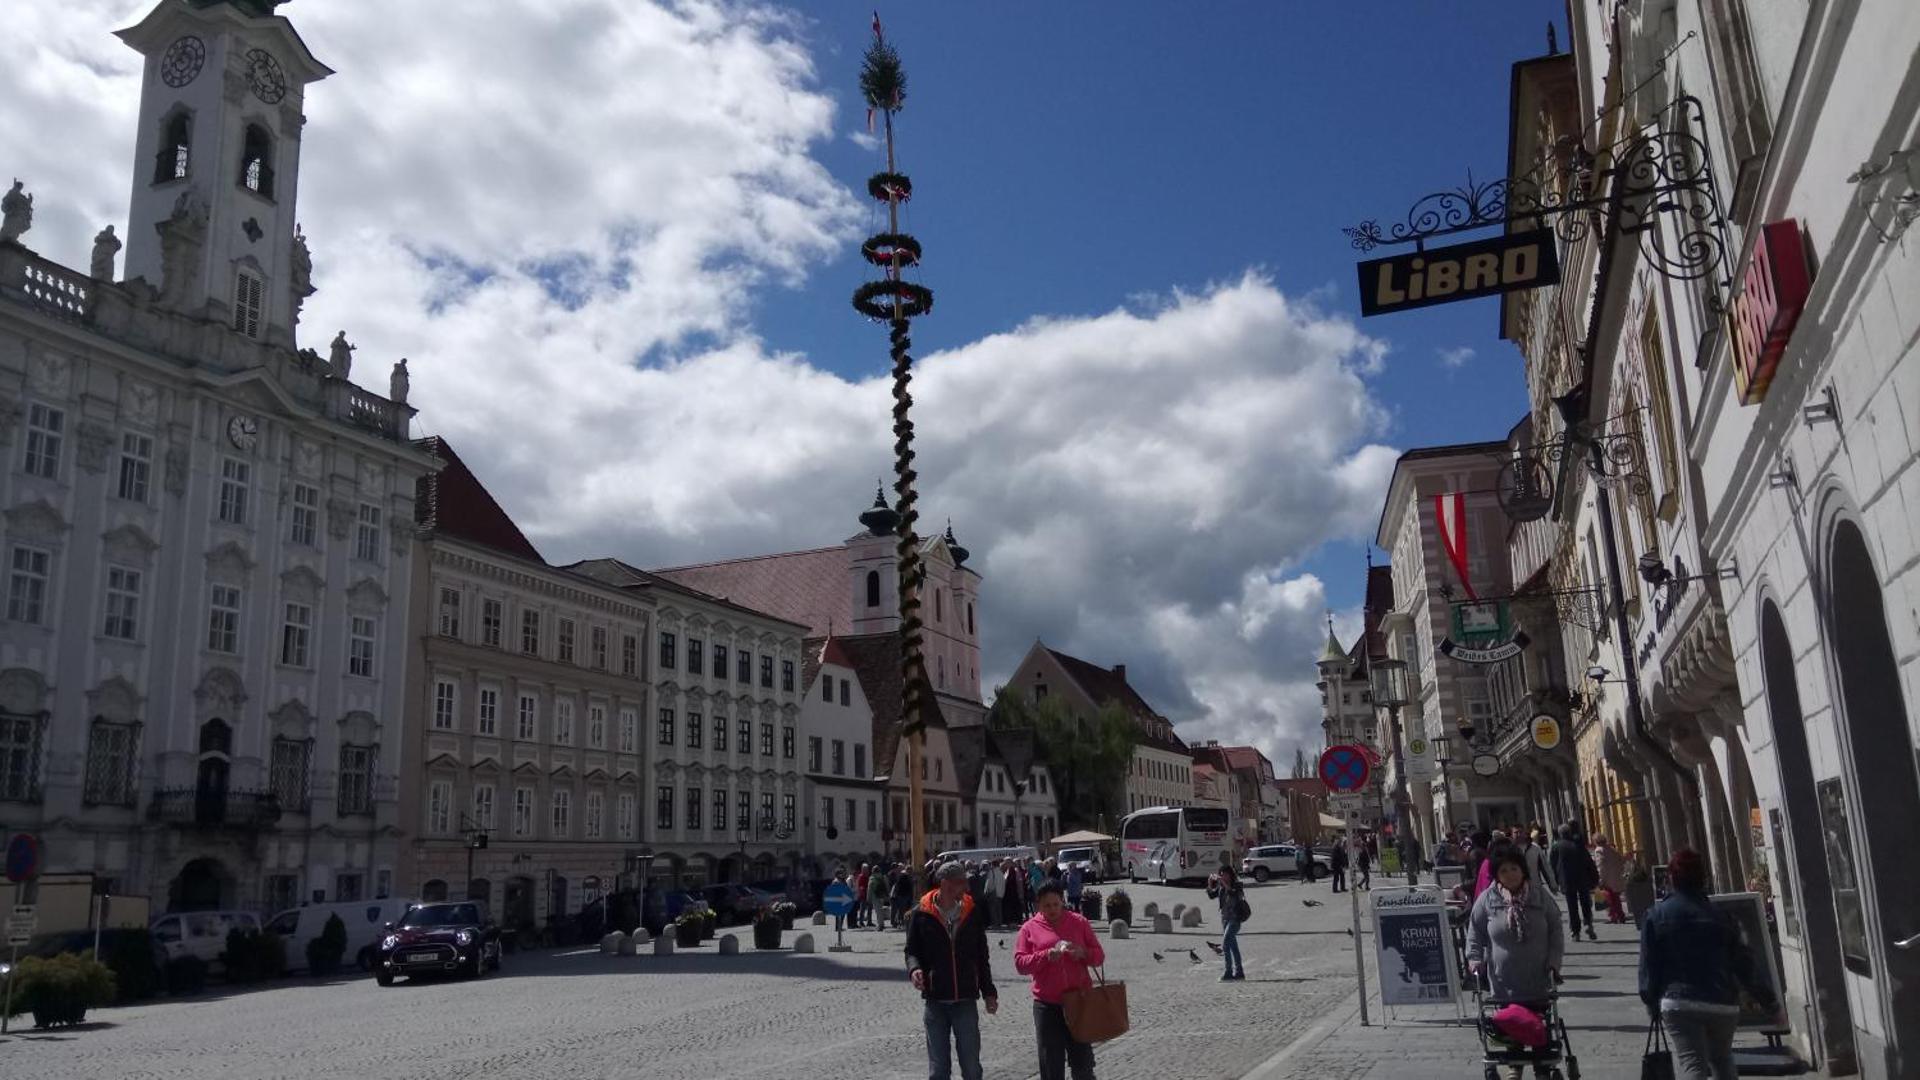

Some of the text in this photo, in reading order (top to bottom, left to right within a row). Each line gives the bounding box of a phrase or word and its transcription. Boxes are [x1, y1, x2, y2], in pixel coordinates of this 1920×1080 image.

[1376, 244, 1539, 305] LiBRO
[1401, 928, 1437, 938] KRIMI
[1402, 938, 1438, 948] NACHT
